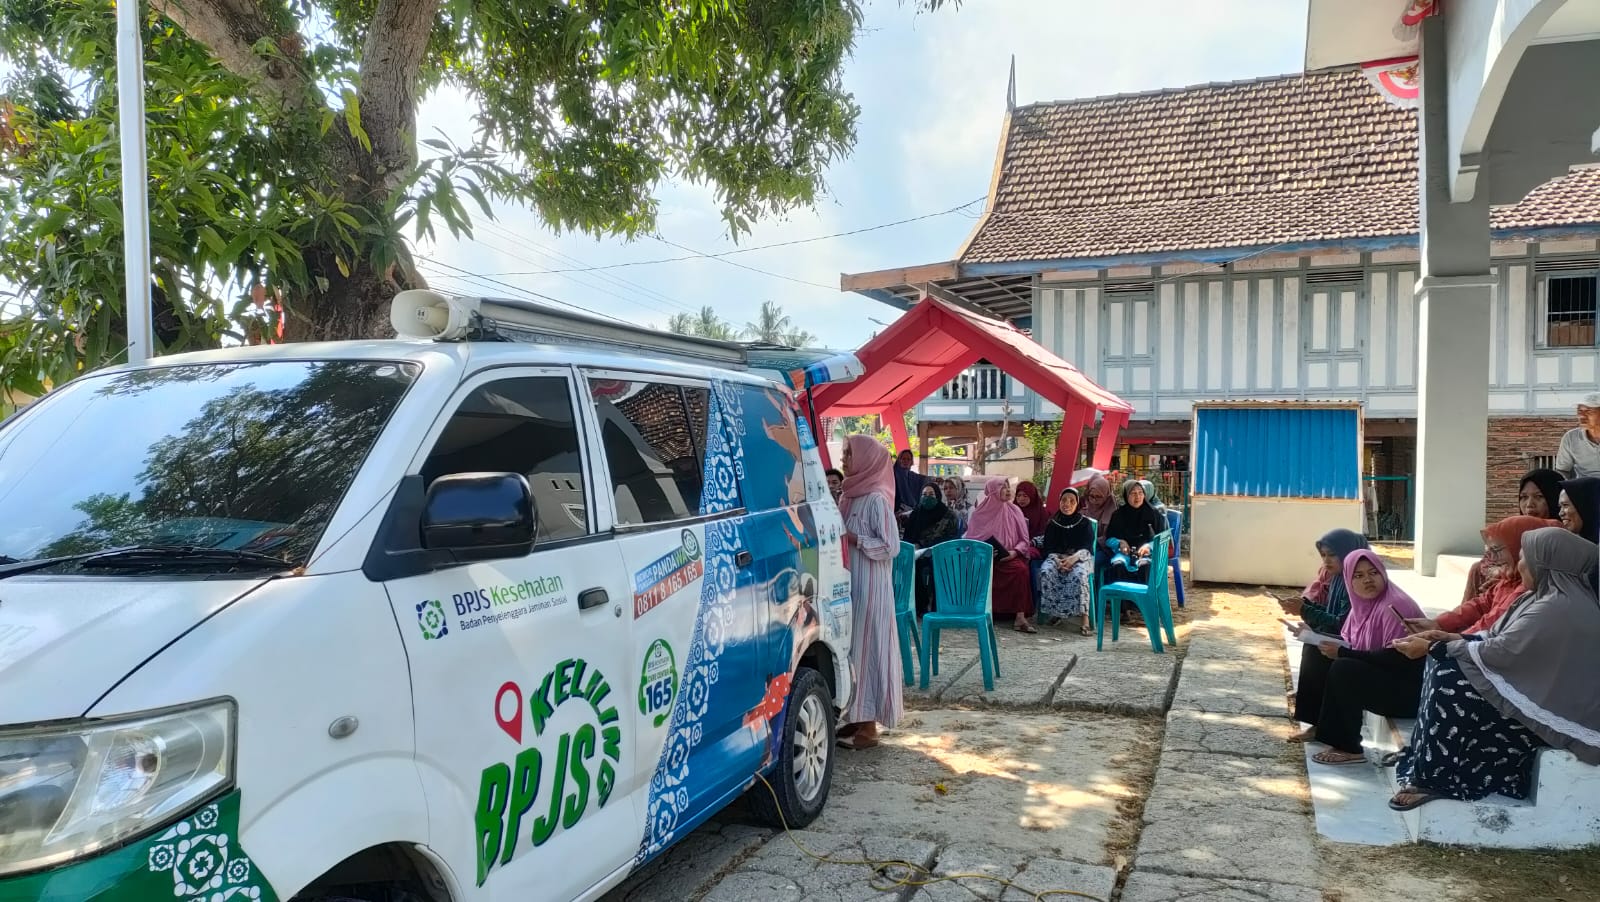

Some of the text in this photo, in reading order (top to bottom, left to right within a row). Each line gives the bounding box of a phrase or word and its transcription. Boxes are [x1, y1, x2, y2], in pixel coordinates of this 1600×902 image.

[653, 547, 688, 581] PANDAWA
[452, 575, 564, 616] BPJS Kesehatan
[637, 587, 658, 615] 0811
[660, 582, 666, 599] 8
[668, 573, 683, 594] 165
[684, 562, 698, 583] 165
[460, 615, 482, 631] Badan
[482, 606, 528, 625] Penyelenggara
[528, 600, 552, 614] Jaminan
[646, 676, 672, 713] 165
[530, 658, 620, 810] KELILING
[475, 723, 596, 888] BPJS
